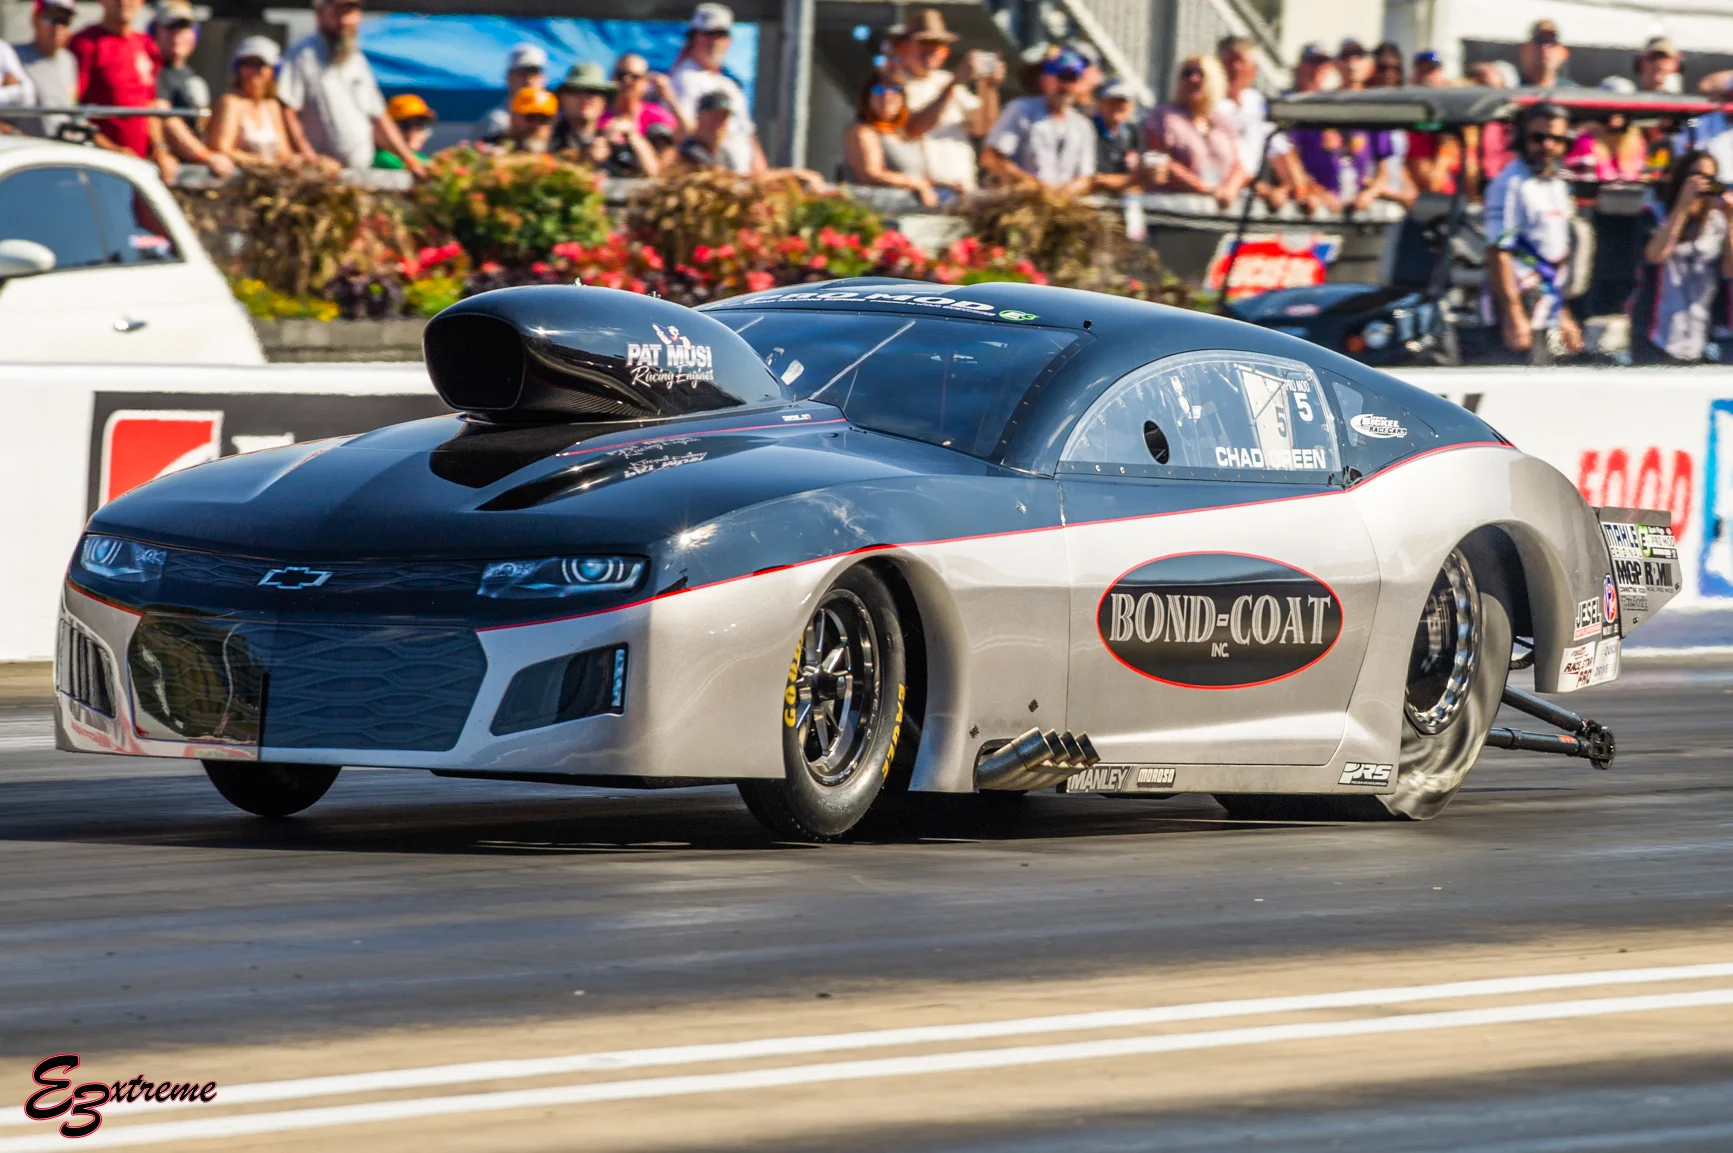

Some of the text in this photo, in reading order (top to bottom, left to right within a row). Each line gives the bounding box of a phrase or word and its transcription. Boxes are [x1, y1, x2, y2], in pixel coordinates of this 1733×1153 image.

[864, 293, 995, 311] MOD
[626, 343, 713, 368] PAT MUSI
[630, 364, 714, 389] Racing Engines
[1284, 379, 1310, 393] PRO MOD
[1293, 391, 1314, 422] 5
[1275, 405, 1288, 438] 5
[1369, 426, 1387, 434] RACE
[1215, 446, 1327, 470] CHAD GREEN
[1603, 523, 1640, 549] MAHLE
[1614, 560, 1642, 585] MGP
[1109, 592, 1331, 646] BOND-COAT
[1575, 598, 1601, 629] JESEL
[1211, 643, 1230, 658] INC.
[1576, 668, 1593, 688] PRO
[1067, 768, 1129, 790] MANLEY
[1137, 767, 1176, 784] MOROSO
[1338, 762, 1393, 784] PRS
